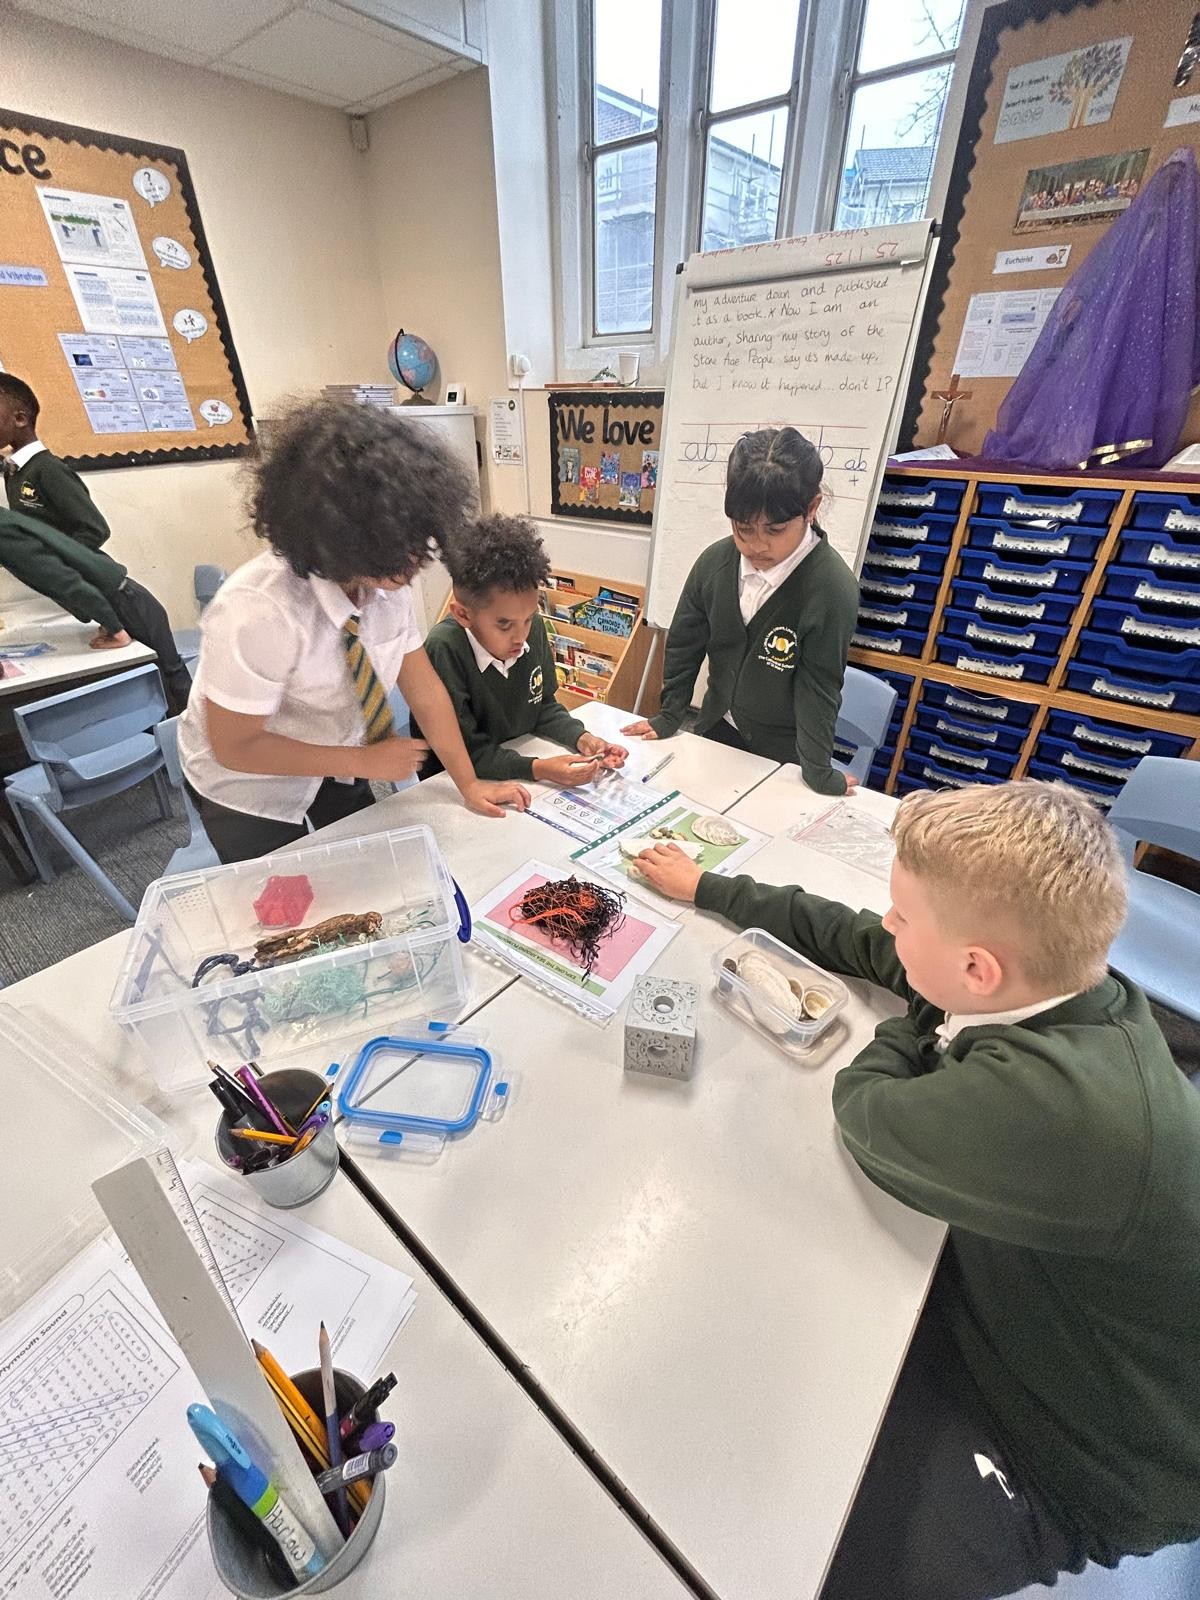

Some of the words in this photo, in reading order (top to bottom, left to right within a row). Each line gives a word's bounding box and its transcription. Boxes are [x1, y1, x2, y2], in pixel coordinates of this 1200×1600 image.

[1004, 255, 1034, 265] Eucharist
[694, 299, 708, 314] my
[714, 291, 757, 306] adventure
[766, 289, 790, 301] down
[801, 282, 825, 297] and
[835, 276, 889, 298] published
[706, 315, 718, 325] as
[723, 313, 731, 323] a
[781, 302, 800, 316] Now
[808, 301, 818, 316] I
[824, 303, 842, 313] am
[859, 299, 879, 310] an
[782, 332, 798, 350] my
[804, 328, 831, 347] story
[840, 325, 855, 337] of
[867, 324, 884, 337] the
[748, 348, 775, 369] People
[783, 355, 800, 370] say
[824, 350, 852, 363] made
[692, 371, 708, 389] but
[761, 377, 771, 390] it
[876, 375, 893, 392] I?
[559, 408, 595, 444] We
[601, 408, 655, 446] love
[844, 449, 868, 471] ab
[40, 1309, 67, 1336] Sound
[265, 1503, 307, 1561] Harlow
